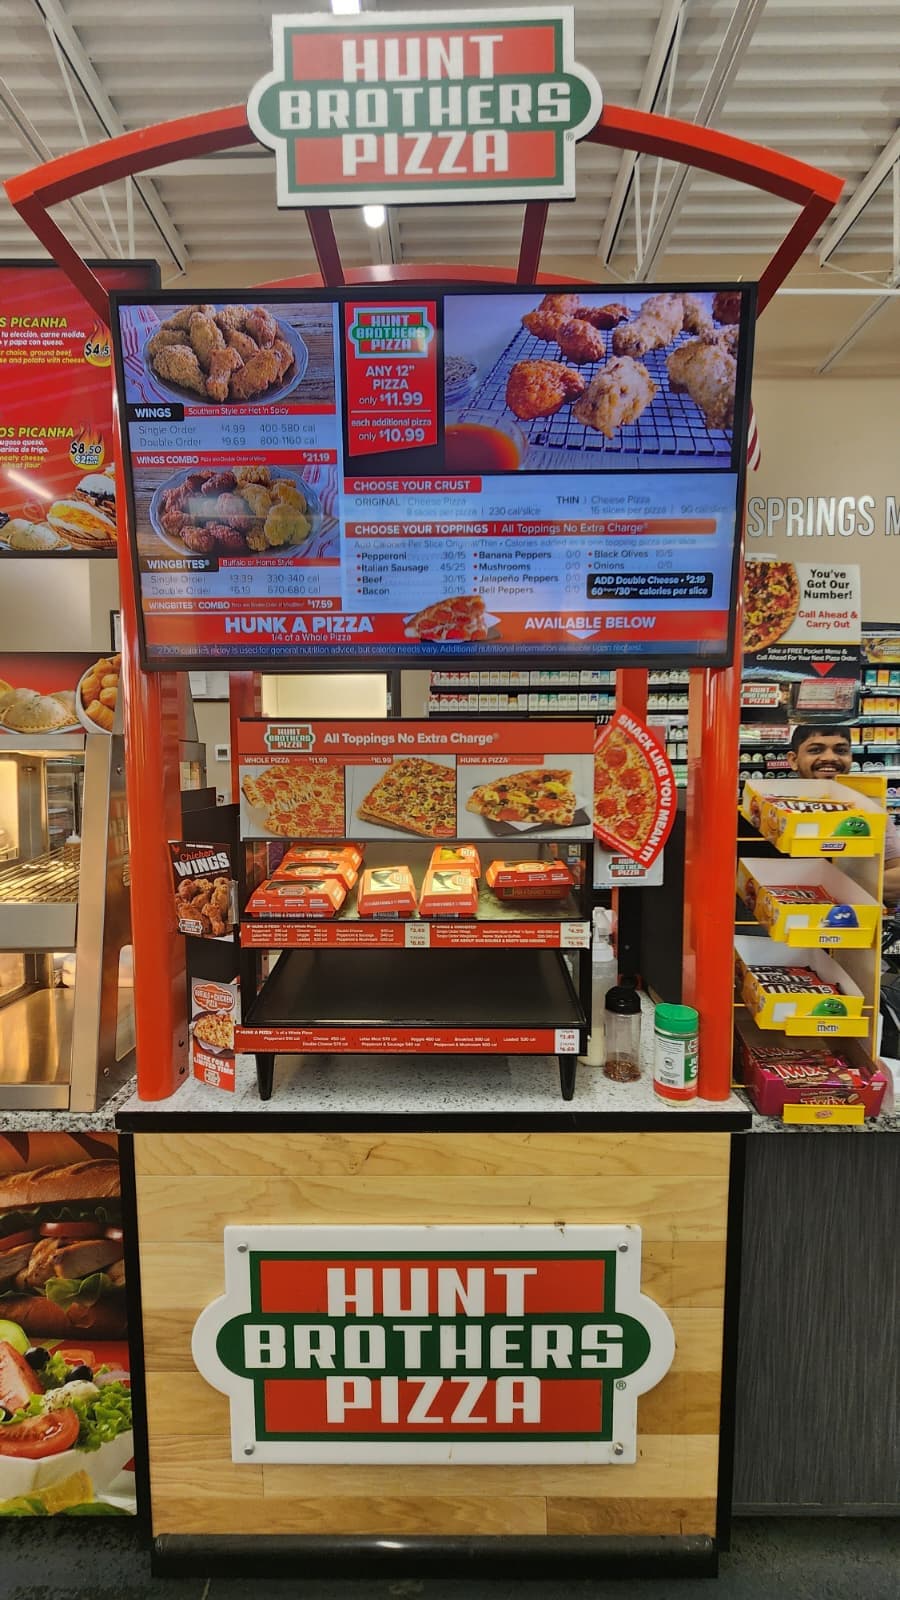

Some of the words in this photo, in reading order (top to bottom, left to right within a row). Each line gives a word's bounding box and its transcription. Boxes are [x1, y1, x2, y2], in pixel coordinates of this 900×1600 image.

[343, 35, 503, 83] HUNT
[279, 82, 571, 130] BROTHERS
[342, 129, 509, 176] PIZZA
[11, 317, 68, 328] PICANHA
[371, 315, 409, 326] HUNT
[356, 327, 426, 339] BROTHERS
[371, 339, 412, 351] PIZZA
[366, 366, 393, 377] ANY
[373, 379, 409, 390] PIZZA
[359, 397, 378, 407] only
[380, 392, 423, 406] $11.99
[135, 408, 172, 418] WINGS
[221, 408, 238, 417] Style
[271, 407, 289, 416] Spicy
[372, 418, 409, 426] additional
[411, 419, 432, 428] pizza
[18, 427, 74, 438] PICANHA
[138, 425, 167, 436] Single
[170, 425, 196, 434] Order
[221, 424, 245, 433] $4.99
[302, 424, 316, 433] cal
[358, 432, 376, 441] only
[379, 429, 425, 442] $10.99
[139, 438, 174, 447] Double
[176, 438, 201, 446] Order
[221, 437, 246, 446] $9.69
[304, 437, 317, 446] cal
[70, 442, 102, 456] $8.50
[166, 456, 199, 464] COMBO
[303, 453, 330, 462] $21.19
[354, 482, 399, 491] CHOOSE
[402, 481, 432, 490] YOUR
[435, 480, 471, 489] CRUST
[355, 498, 400, 507] ORIGINAL
[557, 496, 579, 504] THIN
[591, 496, 625, 504] Cheese
[628, 496, 650, 504] Pizza
[489, 507, 505, 516] 230
[747, 496, 876, 537] SPRINGS
[355, 525, 400, 534] CHOOSE
[402, 525, 432, 534] YOUR
[435, 524, 488, 534] TOPPINGS
[501, 524, 513, 533] All
[517, 524, 560, 535] Toppings
[563, 524, 577, 532] No
[580, 523, 604, 532] Extra
[362, 552, 407, 562] Pepperoni
[515, 552, 552, 561] Peppers
[223, 559, 246, 567] Buffalo
[277, 558, 294, 567] Style
[479, 563, 531, 571] Mushrooms
[593, 562, 624, 570] Onions
[361, 564, 389, 572] Italian
[391, 564, 429, 573] Sausage
[522, 574, 559, 583] Peppers
[594, 575, 613, 585] ADD
[615, 575, 646, 584] Double
[647, 575, 680, 584] Cheese
[807, 580, 826, 588] Got
[829, 580, 850, 589] Our
[362, 587, 390, 595] Bacon
[497, 586, 534, 595] Peppers
[638, 586, 671, 595] calories
[672, 588, 687, 597] per
[689, 586, 708, 595] slice
[804, 591, 852, 599] Number!
[199, 601, 230, 609] COMBO
[308, 600, 333, 608] $17.59
[225, 617, 287, 634] HUNK
[291, 617, 308, 633] A
[312, 617, 373, 633] PIZZA
[525, 617, 601, 629] AVAILABLE
[605, 617, 656, 628] BELOW
[806, 621, 831, 629] Carry
[302, 633, 329, 641] Whole
[617, 714, 656, 751] SNACK
[324, 733, 339, 743] All
[342, 733, 395, 746] Toppings
[398, 733, 414, 743] No
[417, 733, 447, 743] Extra
[649, 749, 670, 778] LIKE
[660, 778, 672, 807] YOU
[648, 809, 670, 846] MEAN
[639, 848, 653, 862] IT!
[173, 852, 230, 877] WINGS
[327, 1267, 537, 1318] HUNT
[243, 1325, 624, 1369] BROTHERS
[326, 1376, 541, 1424] PIZZA
